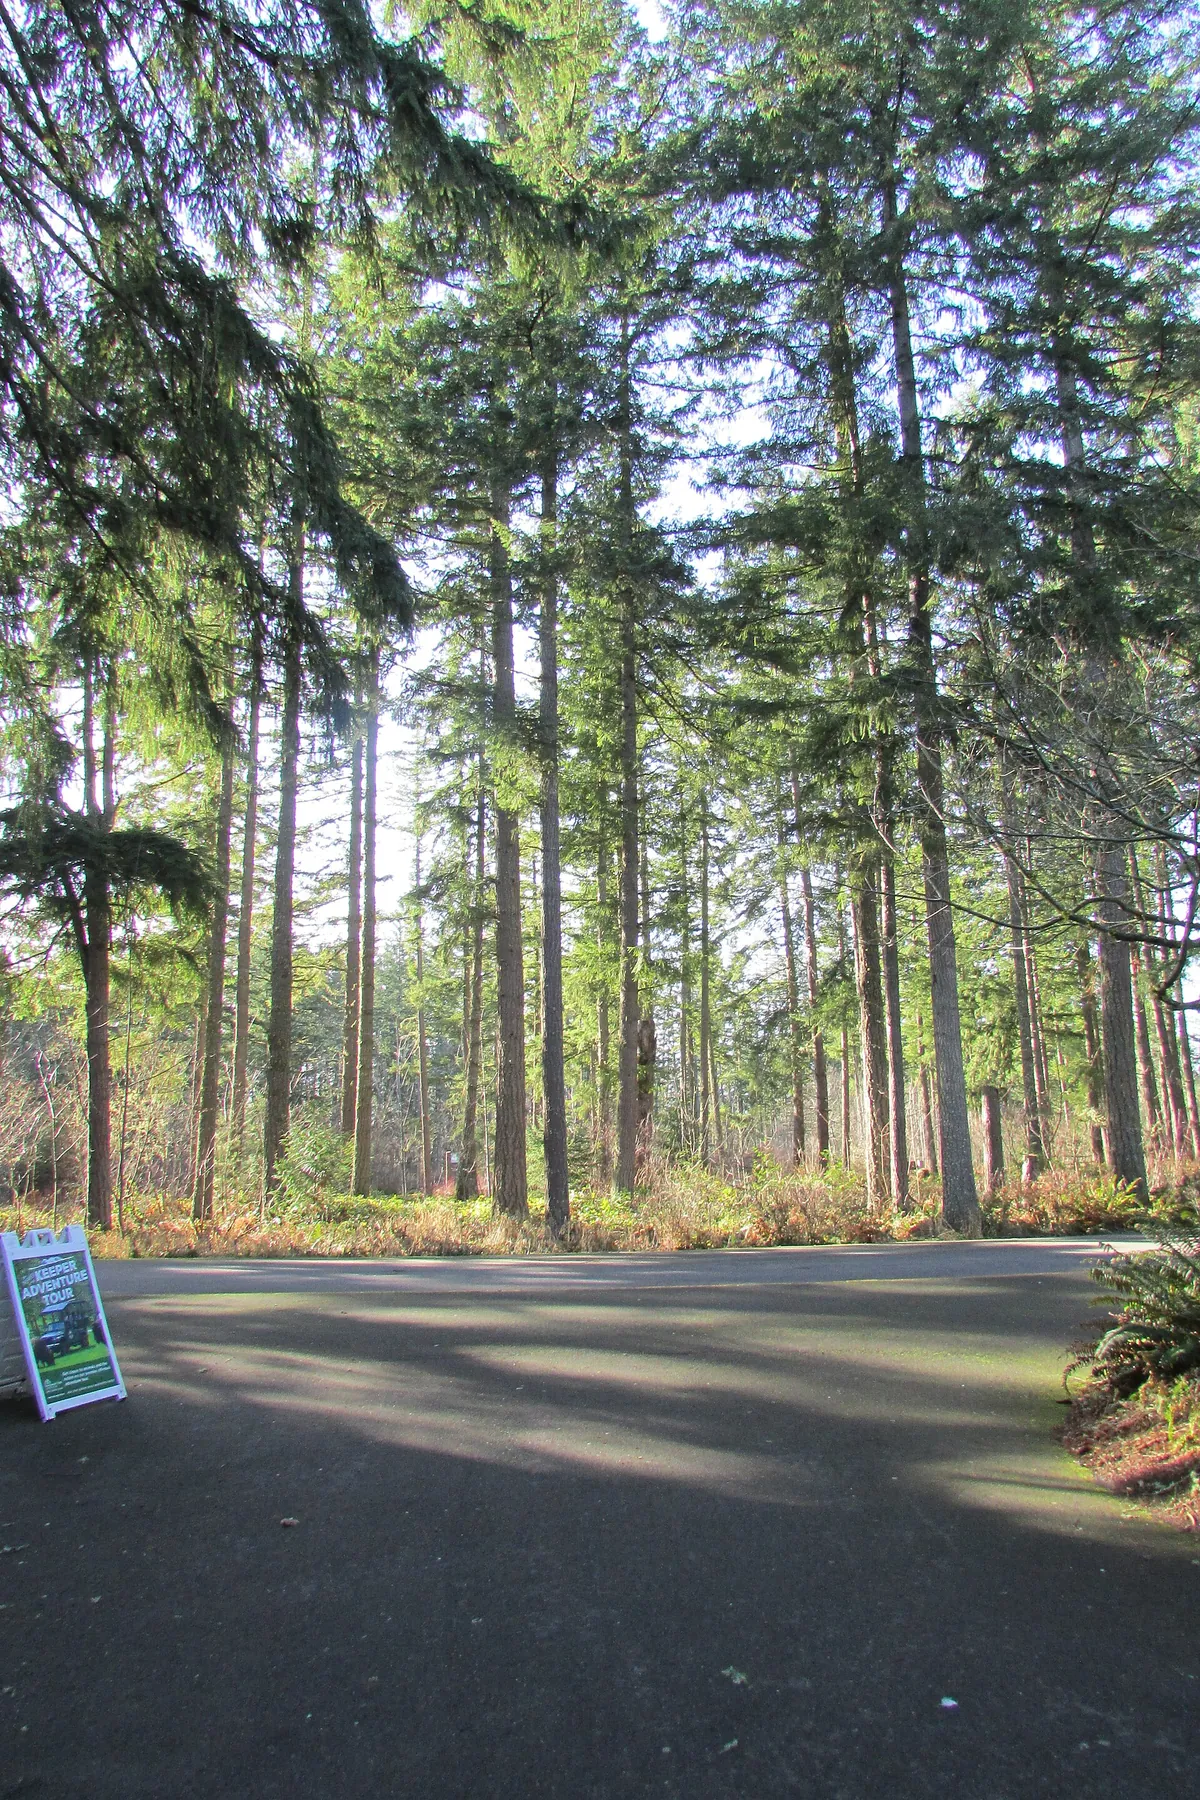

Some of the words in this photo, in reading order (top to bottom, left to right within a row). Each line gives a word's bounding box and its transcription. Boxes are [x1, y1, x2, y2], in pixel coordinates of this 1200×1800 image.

[34, 1260, 77, 1282] KEEPER
[22, 1269, 88, 1300] ADVENTURE
[42, 1287, 75, 1306] TOUR
